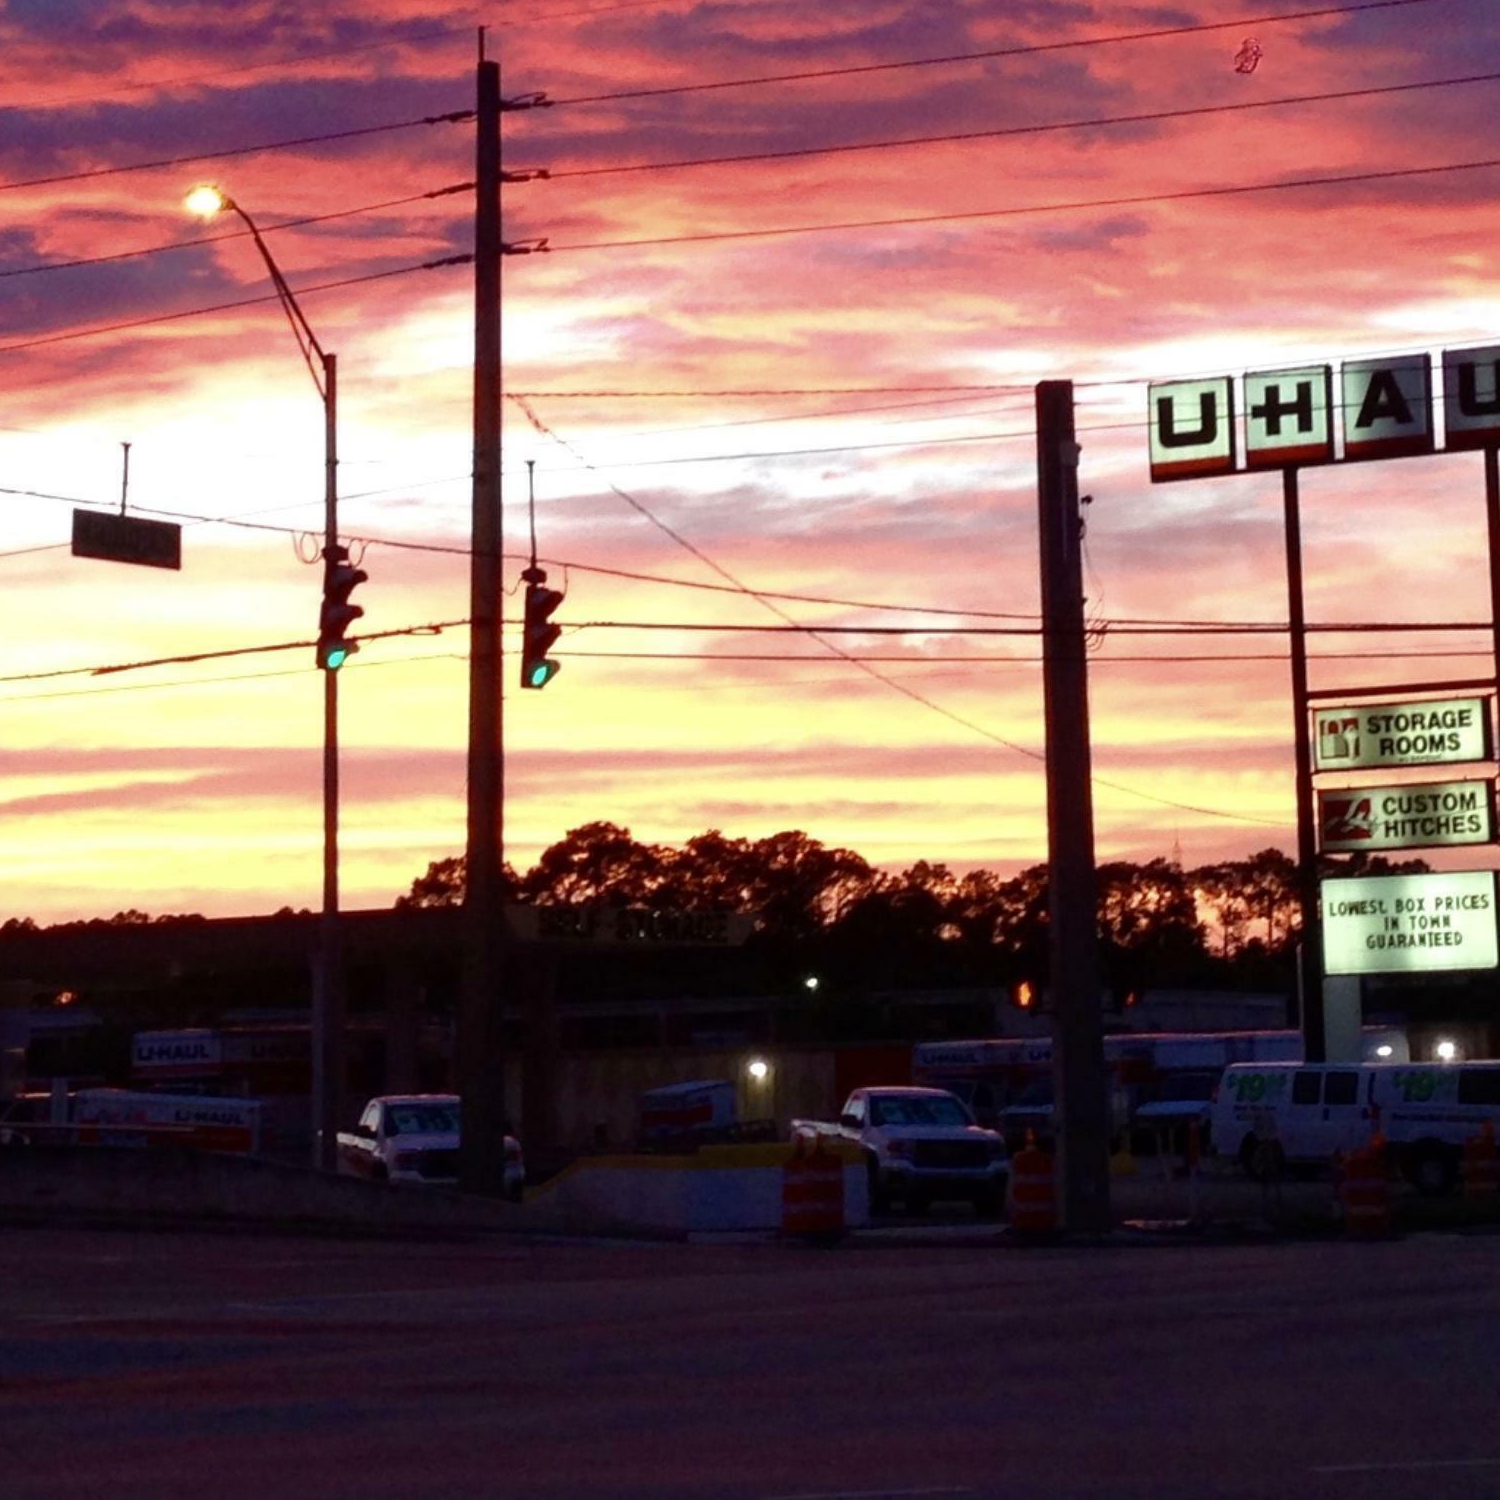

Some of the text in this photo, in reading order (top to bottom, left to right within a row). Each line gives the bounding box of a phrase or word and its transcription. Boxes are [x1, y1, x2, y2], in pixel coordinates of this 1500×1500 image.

[1367, 709, 1473, 734] STORAGE
[1380, 733, 1461, 756] ROOMS
[1382, 792, 1477, 815] CUSTOM
[1384, 815, 1481, 838] HITCHES
[1329, 894, 1490, 917] LOWEST BOX PRICES
[1384, 915, 1451, 931] IN TOWN
[1366, 931, 1463, 950] GUARANTEED
[137, 1044, 210, 1061] U-HAUL
[174, 1108, 244, 1125] U-HAUL
